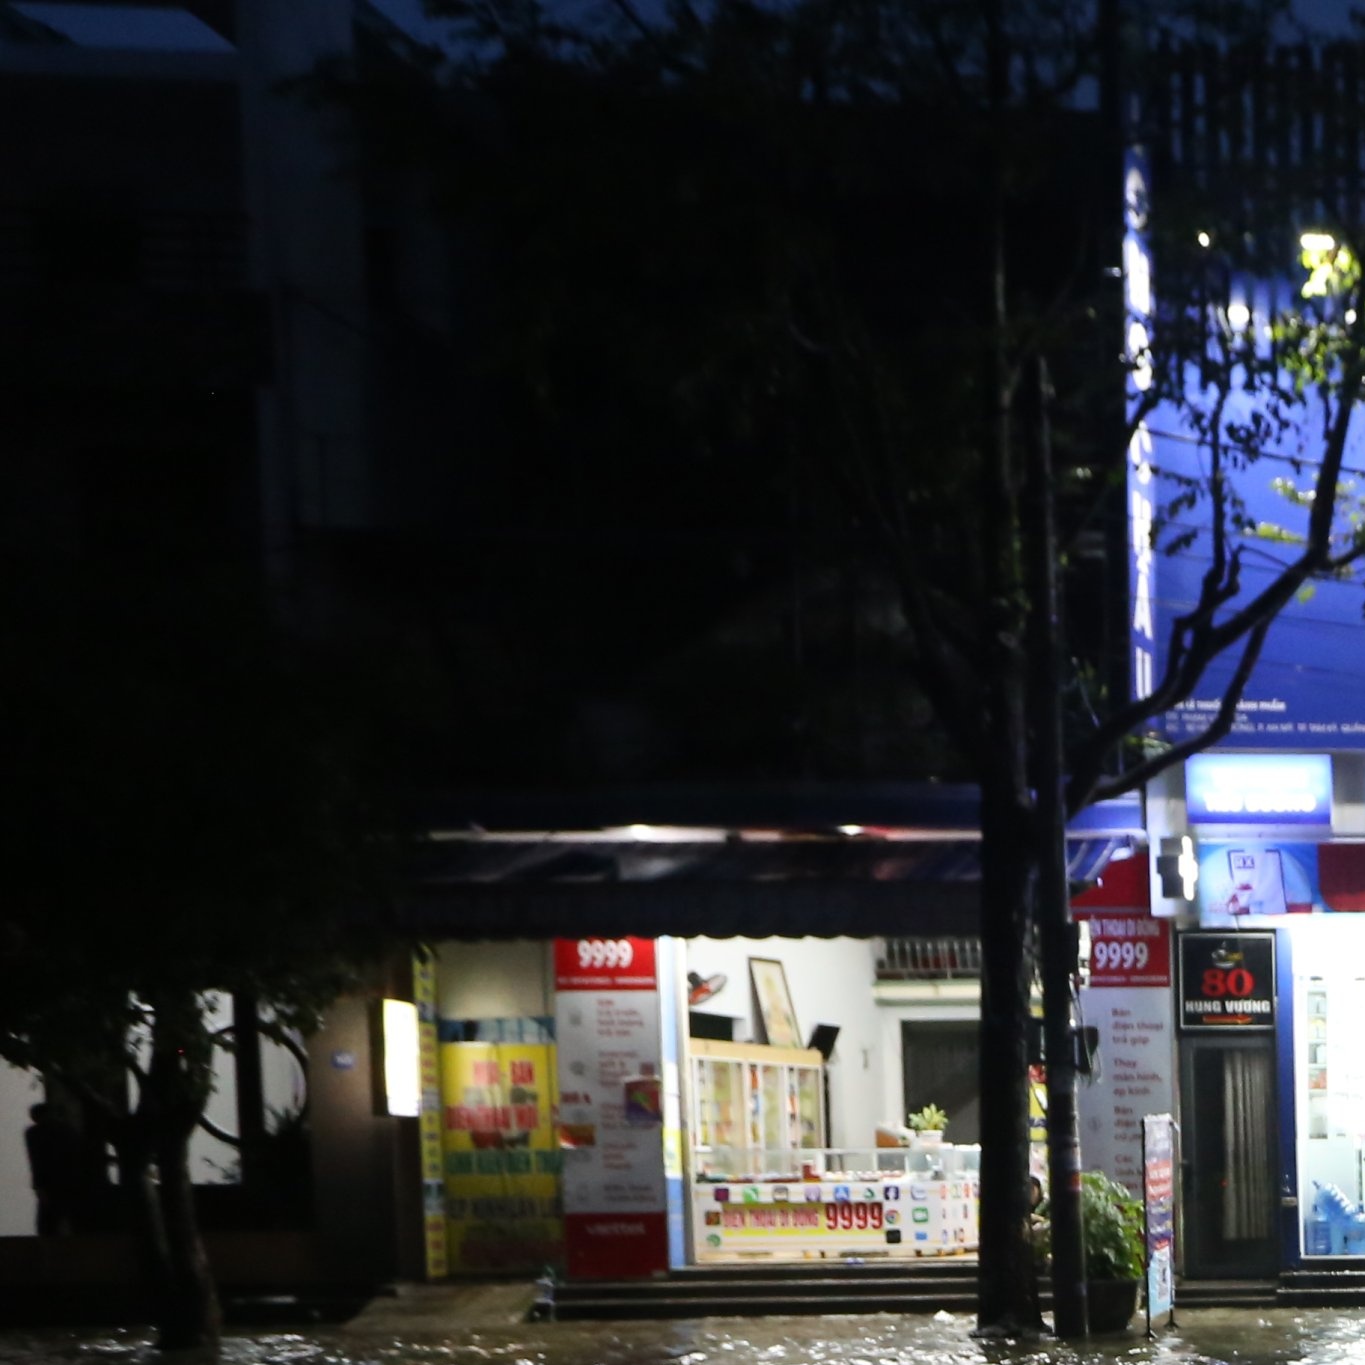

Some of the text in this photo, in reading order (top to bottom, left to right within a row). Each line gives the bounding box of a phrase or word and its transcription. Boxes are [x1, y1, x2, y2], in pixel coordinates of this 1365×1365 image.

[577, 939, 633, 968] 9999
[1094, 942, 1149, 970] 9999
[1201, 969, 1254, 997] 80
[825, 1202, 883, 1230] 9999
